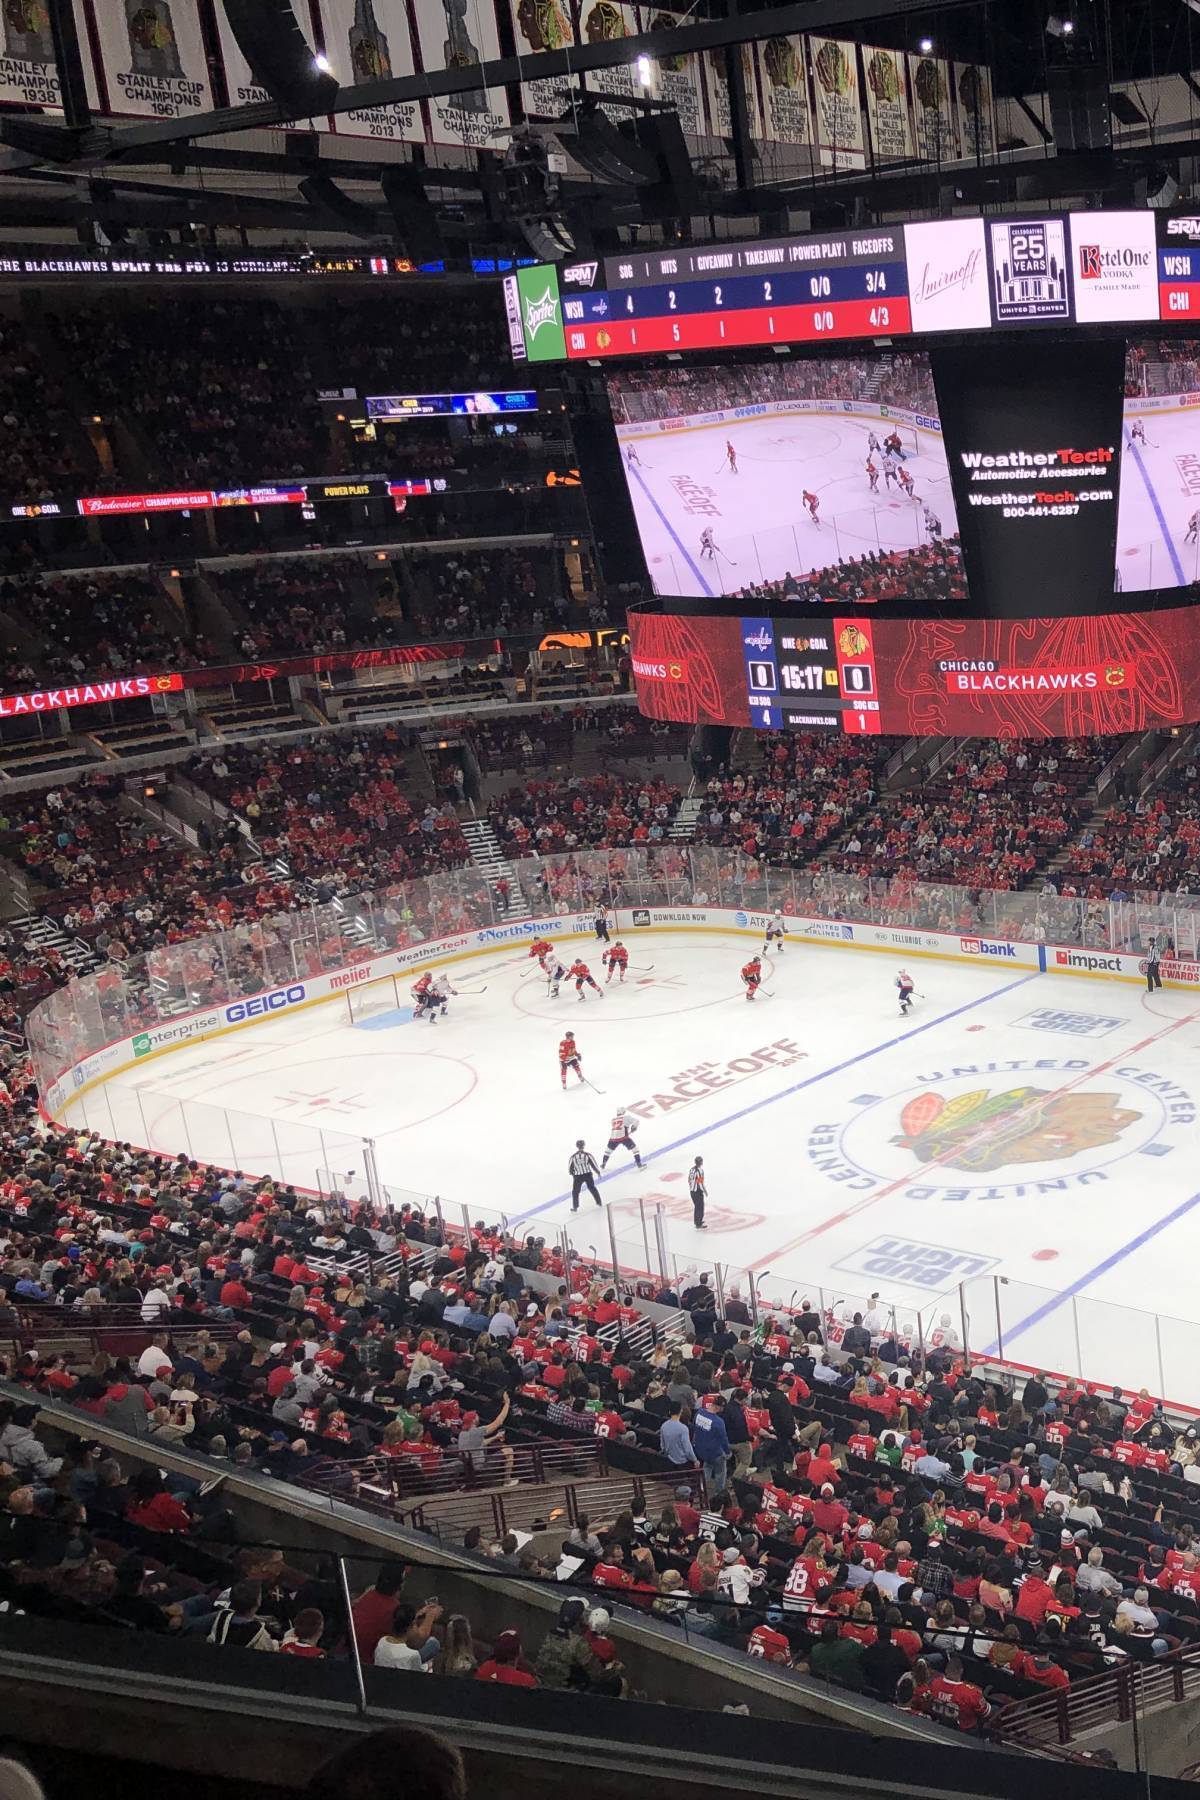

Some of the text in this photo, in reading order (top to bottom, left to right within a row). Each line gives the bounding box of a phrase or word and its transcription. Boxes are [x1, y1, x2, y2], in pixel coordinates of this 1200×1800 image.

[116, 73, 204, 93] STANLEY CUP
[22, 89, 56, 103] 1938
[125, 87, 201, 107] CHAMPIONS
[152, 102, 180, 117] 1961
[393, 104, 416, 116] CUP
[437, 108, 504, 125] STANLEY CUP
[349, 110, 413, 128] CHAMPIONS
[370, 123, 394, 136] 2013
[1012, 235, 1045, 259] 25
[25, 261, 108, 272] BLACKHAWKS
[112, 261, 151, 272] SPLIT
[619, 237, 894, 279] SOG HITS GIVEAWAY TAKEAWAY POWER PLAY FACEOFFS
[1014, 259, 1047, 272] YEARS
[1080, 245, 1151, 274] Ketel One
[1164, 256, 1191, 275] WSH
[563, 266, 592, 284] SRM
[914, 247, 982, 304] Smirnoff
[1102, 270, 1134, 279] VODKA
[564, 271, 887, 319] WSH 4 2 2 2 0/0 3/4
[1169, 292, 1190, 310] CHI
[528, 300, 556, 326] Sprite
[1001, 306, 1029, 314] UNITED
[570, 306, 890, 350] CHI 1 5 1 1 0/0 4/3
[961, 447, 1113, 468] WeatherTech
[971, 466, 1107, 481] Automotive Accessories
[250, 488, 277, 496] CAPITALS
[250, 494, 289, 502] BLACKHAWKS
[324, 485, 369, 496] POWER PLAYS
[968, 490, 1113, 506] WeatherTech.com
[12, 504, 60, 516] ONE GOAL
[87, 495, 208, 512] Budweiser CHAMPIONS CLUB
[1003, 504, 1080, 518] 800-441-6287
[782, 637, 828, 651] ONE GOAL
[940, 661, 995, 672] CHICAGO
[758, 665, 767, 687] 0
[781, 666, 823, 690] 15:17
[852, 667, 864, 689] 0
[957, 672, 1098, 691] BLACKHAWKS
[763, 710, 771, 726] 4
[789, 715, 837, 726] BLACKHAWKS.COM
[859, 714, 865, 730] 1
[653, 912, 690, 922] DOWNLOAD
[692, 913, 706, 922] NOW
[484, 920, 563, 942] NorthShore
[572, 923, 587, 933] LIVE
[891, 933, 922, 946] TELLURIDE
[396, 938, 468, 964] WeatherTech
[1066, 950, 1123, 972] impact
[1184, 964, 1200, 973] FAST
[330, 965, 372, 990] meijer
[225, 985, 306, 1023] GEICO
[134, 1015, 217, 1053] enterprise
[776, 1052, 809, 1068] 2019
[627, 1037, 799, 1119] FACE-OFF
[668, 1061, 720, 1083] NHL
[916, 1059, 1197, 1126] UNITED CENTER
[807, 1122, 1110, 1202] UNITED CENTER
[866, 1239, 989, 1275] LIGHT
[863, 1257, 951, 1287] BUD
